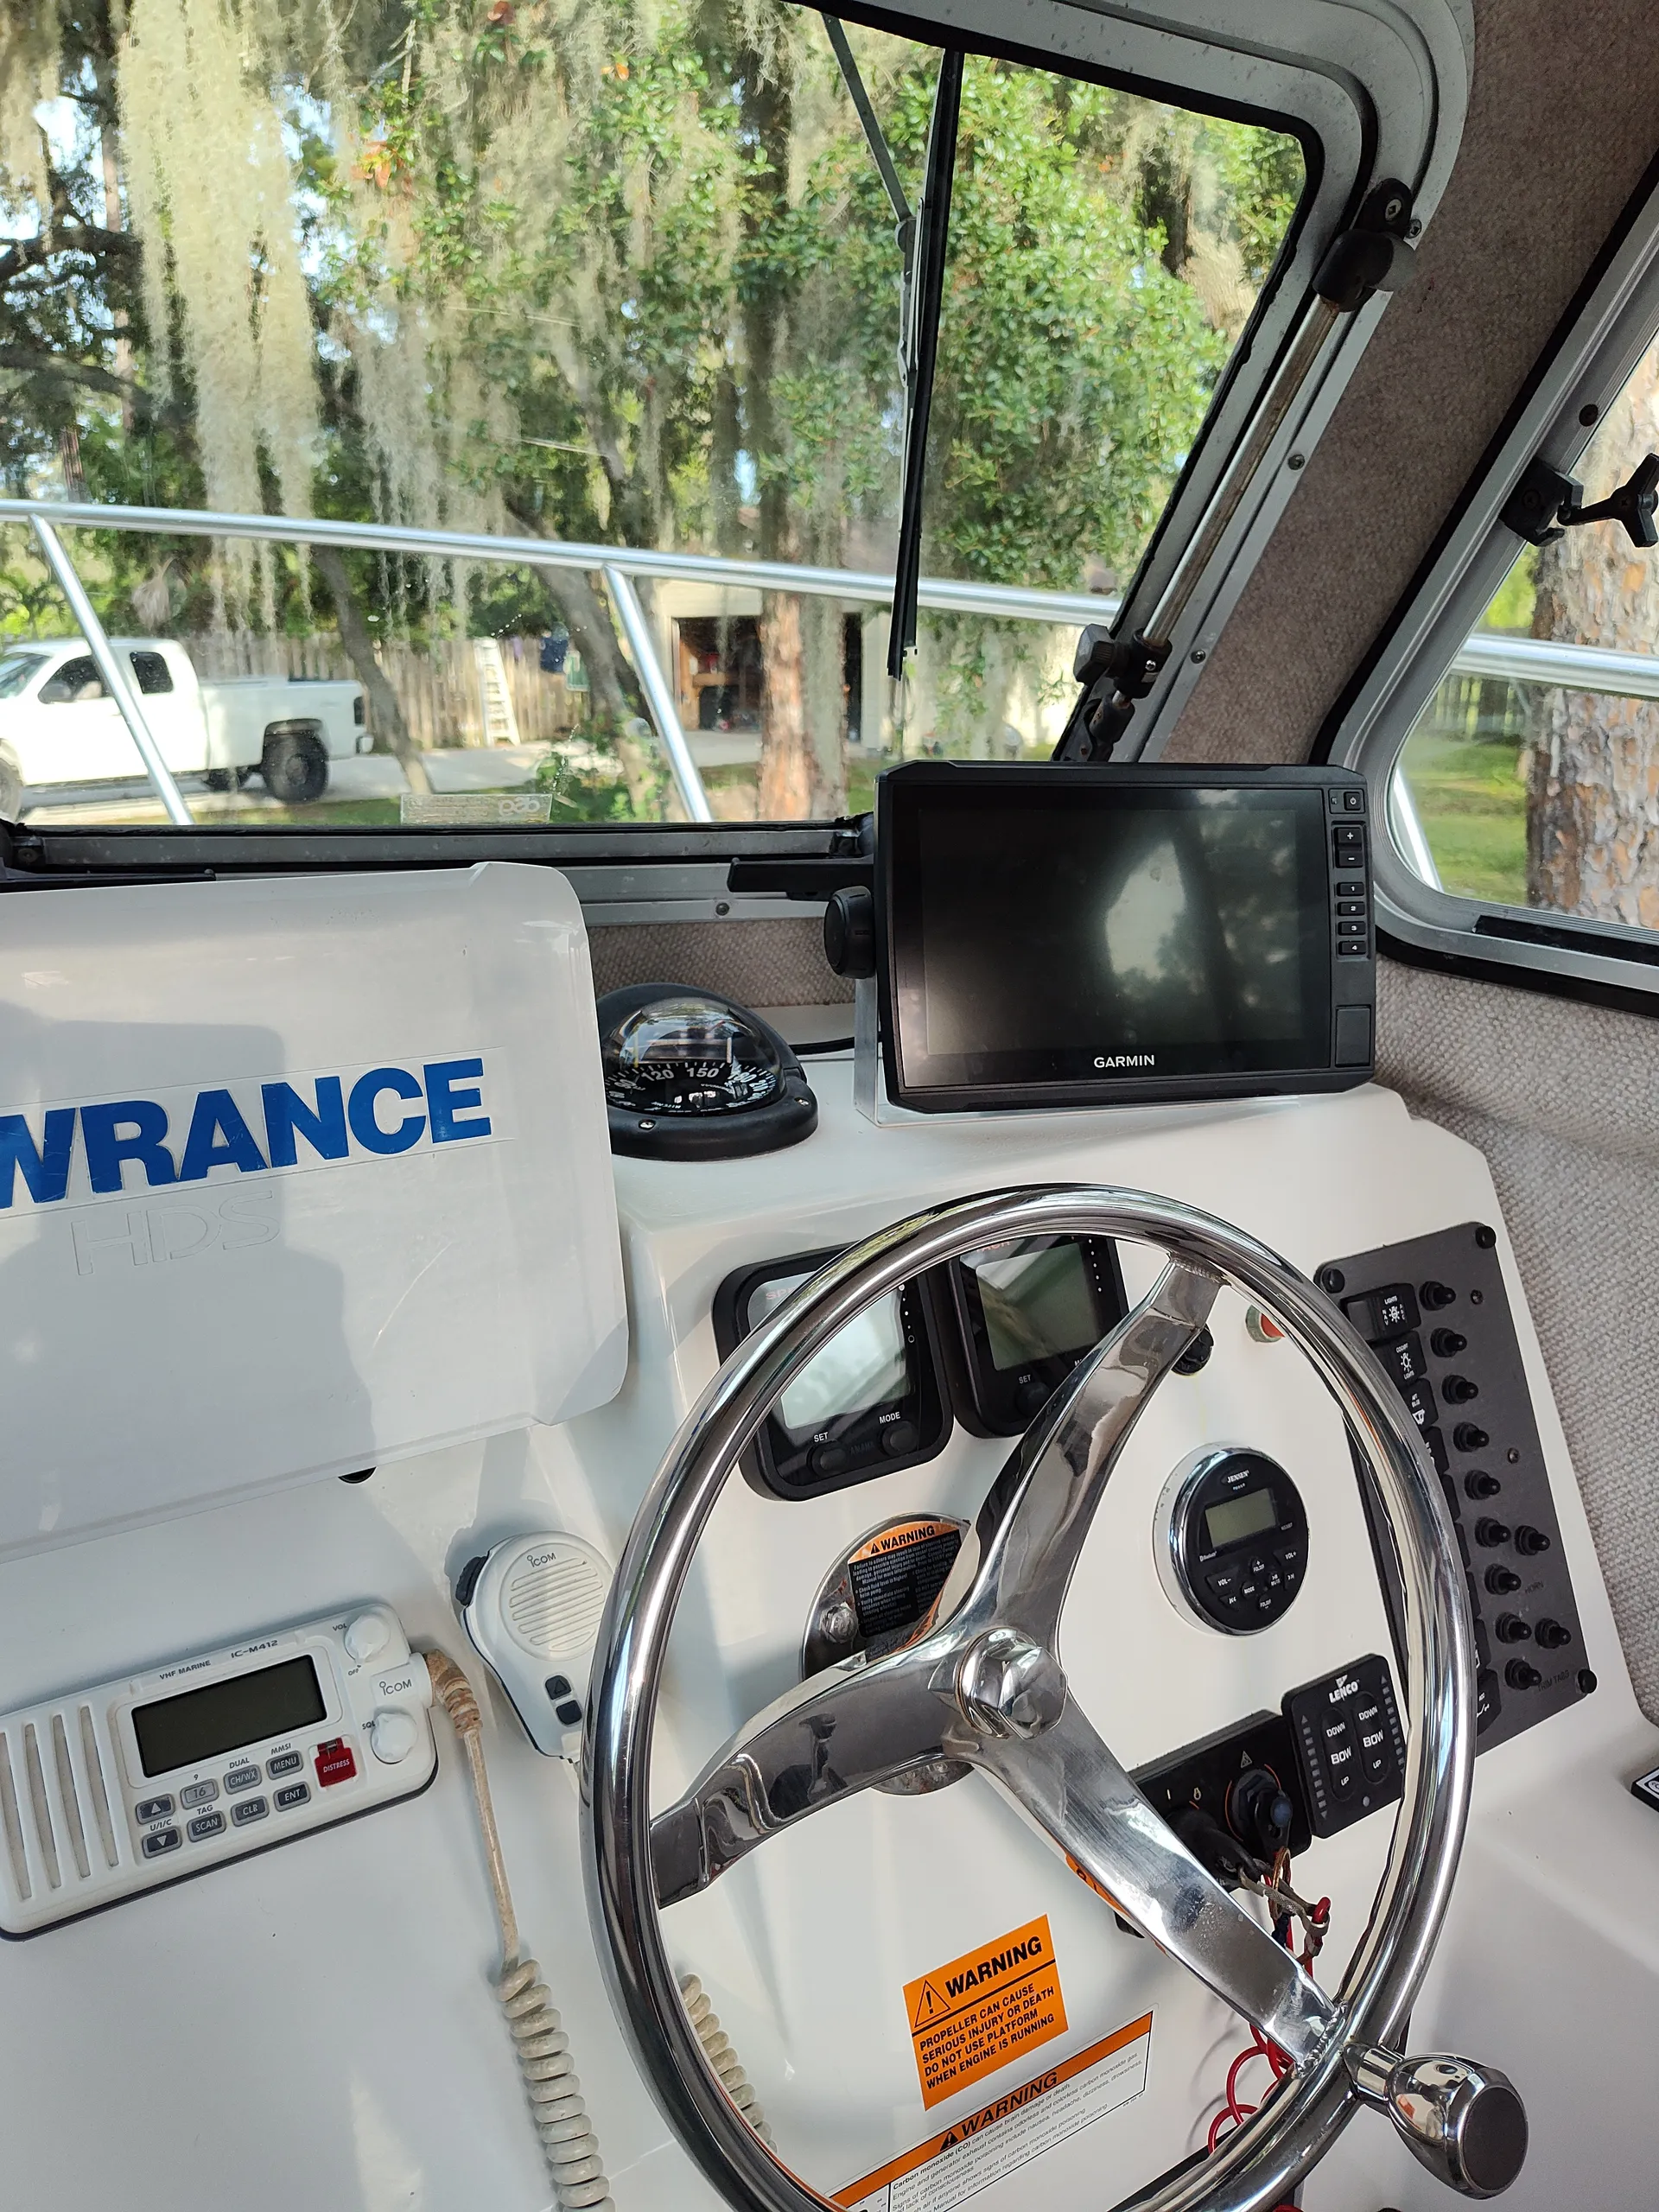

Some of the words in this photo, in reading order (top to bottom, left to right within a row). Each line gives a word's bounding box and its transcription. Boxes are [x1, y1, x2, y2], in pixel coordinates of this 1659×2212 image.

[1093, 1054, 1155, 1069] GARMIN
[641, 1069, 674, 1081] 120
[686, 1067, 720, 1077] 150
[70, 1189, 281, 1276] HDS
[1018, 1374, 1031, 1384] SET
[879, 1411, 901, 1424] MODE
[813, 1432, 829, 1443] SET
[880, 1525, 935, 1551] WARNING
[332, 1623, 347, 1632] VOL
[231, 1639, 278, 1659] IC-M412
[159, 1669, 176, 1681] VHF
[178, 1660, 212, 1675] MARINE
[1328, 1681, 1359, 1704] LENCO
[1358, 1706, 1378, 1721] DOWN
[361, 1719, 376, 1731] SQL
[1325, 1721, 1346, 1738] DOWN
[1363, 1729, 1384, 1748] BOW
[270, 1742, 292, 1755] MMSI
[1331, 1746, 1352, 1765] BOW
[229, 1757, 251, 1770] DUAL
[273, 1756, 297, 1771] MENU
[322, 1758, 350, 1773] DISTRESS
[1372, 1759, 1382, 1770] UP
[230, 1770, 257, 1785] CH/WX
[1340, 1776, 1350, 1786] UP
[193, 1786, 207, 1799] 16
[284, 1788, 302, 1802] ENT
[197, 1804, 213, 1815] TAG
[243, 1803, 259, 1815] CLR
[149, 1818, 172, 1832] U/I/C
[195, 1817, 219, 1833] SCAN
[944, 1936, 1042, 1999] WARNING
[919, 2011, 978, 2051] PROPELLER
[979, 2003, 1001, 2019] CAN
[1002, 1983, 1035, 2008] CAUSE
[922, 2036, 967, 2064] SERIOUS
[969, 2013, 1004, 2039] INJURY
[1007, 2005, 1021, 2018] OR
[1023, 1986, 1055, 2011] DEATH
[924, 2063, 939, 2077] DO
[941, 2049, 963, 2069] NOT
[964, 2037, 985, 2056] USE
[987, 2008, 1039, 2044] PLATFORM
[926, 2068, 957, 2090] WHEN
[959, 2044, 997, 2073] ENGINE
[998, 2038, 1009, 2050] IS
[1010, 2013, 1055, 2044] RUNNING
[961, 2071, 1058, 2138] WARNING
[893, 2183, 916, 2201] Engine
[917, 2174, 930, 2186] and
[931, 2158, 961, 2181] generator
[962, 2141, 988, 2159] exhaust
[988, 2126, 1014, 2145] contains
[1014, 2111, 1039, 2130] odorless
[1040, 2102, 1052, 2113] and
[1052, 2088, 1079, 2107] colorless
[1079, 2076, 1099, 2090] carbon
[1099, 2061, 1127, 2079] monoxide
[893, 2171, 919, 2190] Carbon
[920, 2152, 954, 2175] monoxide
[955, 2141, 971, 2157] (CO)
[971, 2134, 984, 2145] can
[984, 2123, 1003, 2137] cause
[1004, 2113, 1020, 2126] brain
[1020, 2099, 1045, 2117] damage
[1046, 2093, 1052, 2101] or
[893, 2197, 911, 2212] Signs
[912, 2190, 919, 2200] of
[919, 2178, 943, 2196] carbon
[944, 2160, 974, 2182] monoxide
[975, 2141, 1004, 2164] poisoning
[1005, 2128, 1027, 2145] include
[922, 2200, 931, 2209] air
[938, 2183, 961, 2201] anyone
[962, 2171, 982, 2186] shows
[982, 2159, 1000, 2173] signs
[1000, 2154, 1007, 2163] of
[1007, 2142, 1028, 2157] carbon
[1029, 2126, 1058, 2145] monoxide
[933, 2195, 957, 2211] Manual
[957, 2189, 967, 2198] for
[967, 2167, 1001, 2192] information
[1002, 2151, 1031, 2171] regarding
[1031, 2138, 1052, 2152] carbon
[1052, 2121, 1080, 2140] monoxide
[906, 2197, 919, 2211] lack
[920, 2191, 927, 2201] of
